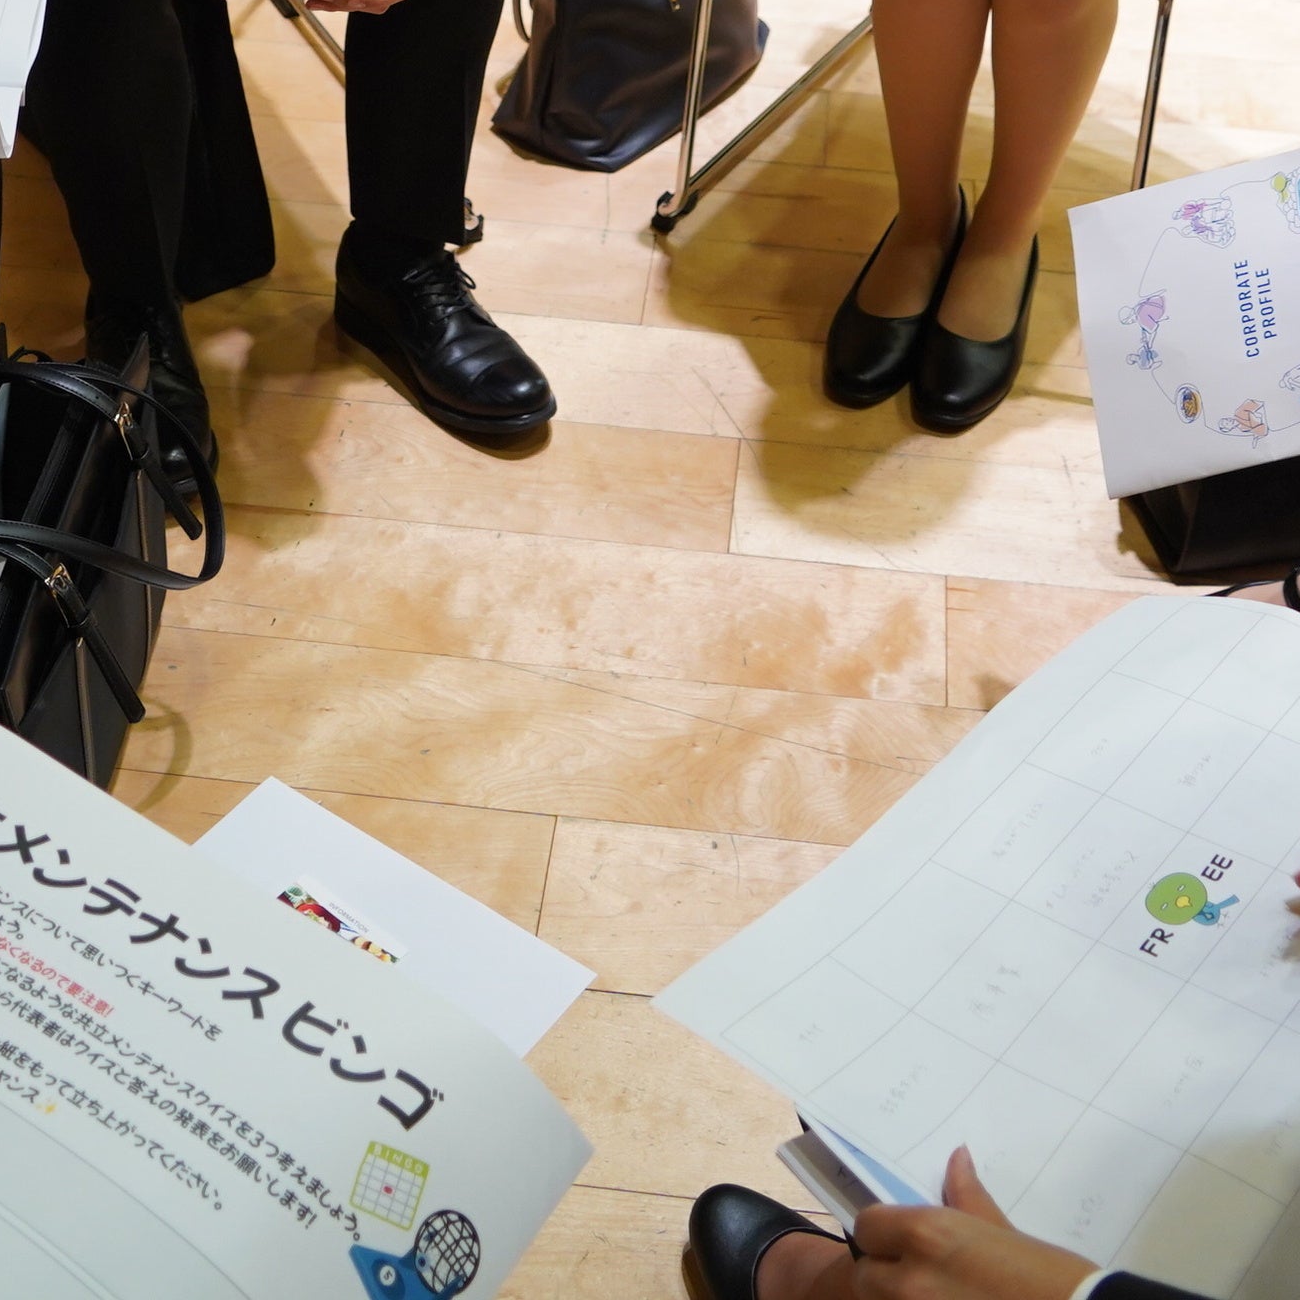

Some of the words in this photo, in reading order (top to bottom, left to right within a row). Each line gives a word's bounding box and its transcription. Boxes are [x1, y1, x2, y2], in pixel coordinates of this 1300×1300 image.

[1233, 259, 1260, 358] CORPORATE
[1255, 267, 1277, 339] PROFILE
[282, 1000, 444, 1131] ビンゴ
[373, 1143, 424, 1175] BINGO
